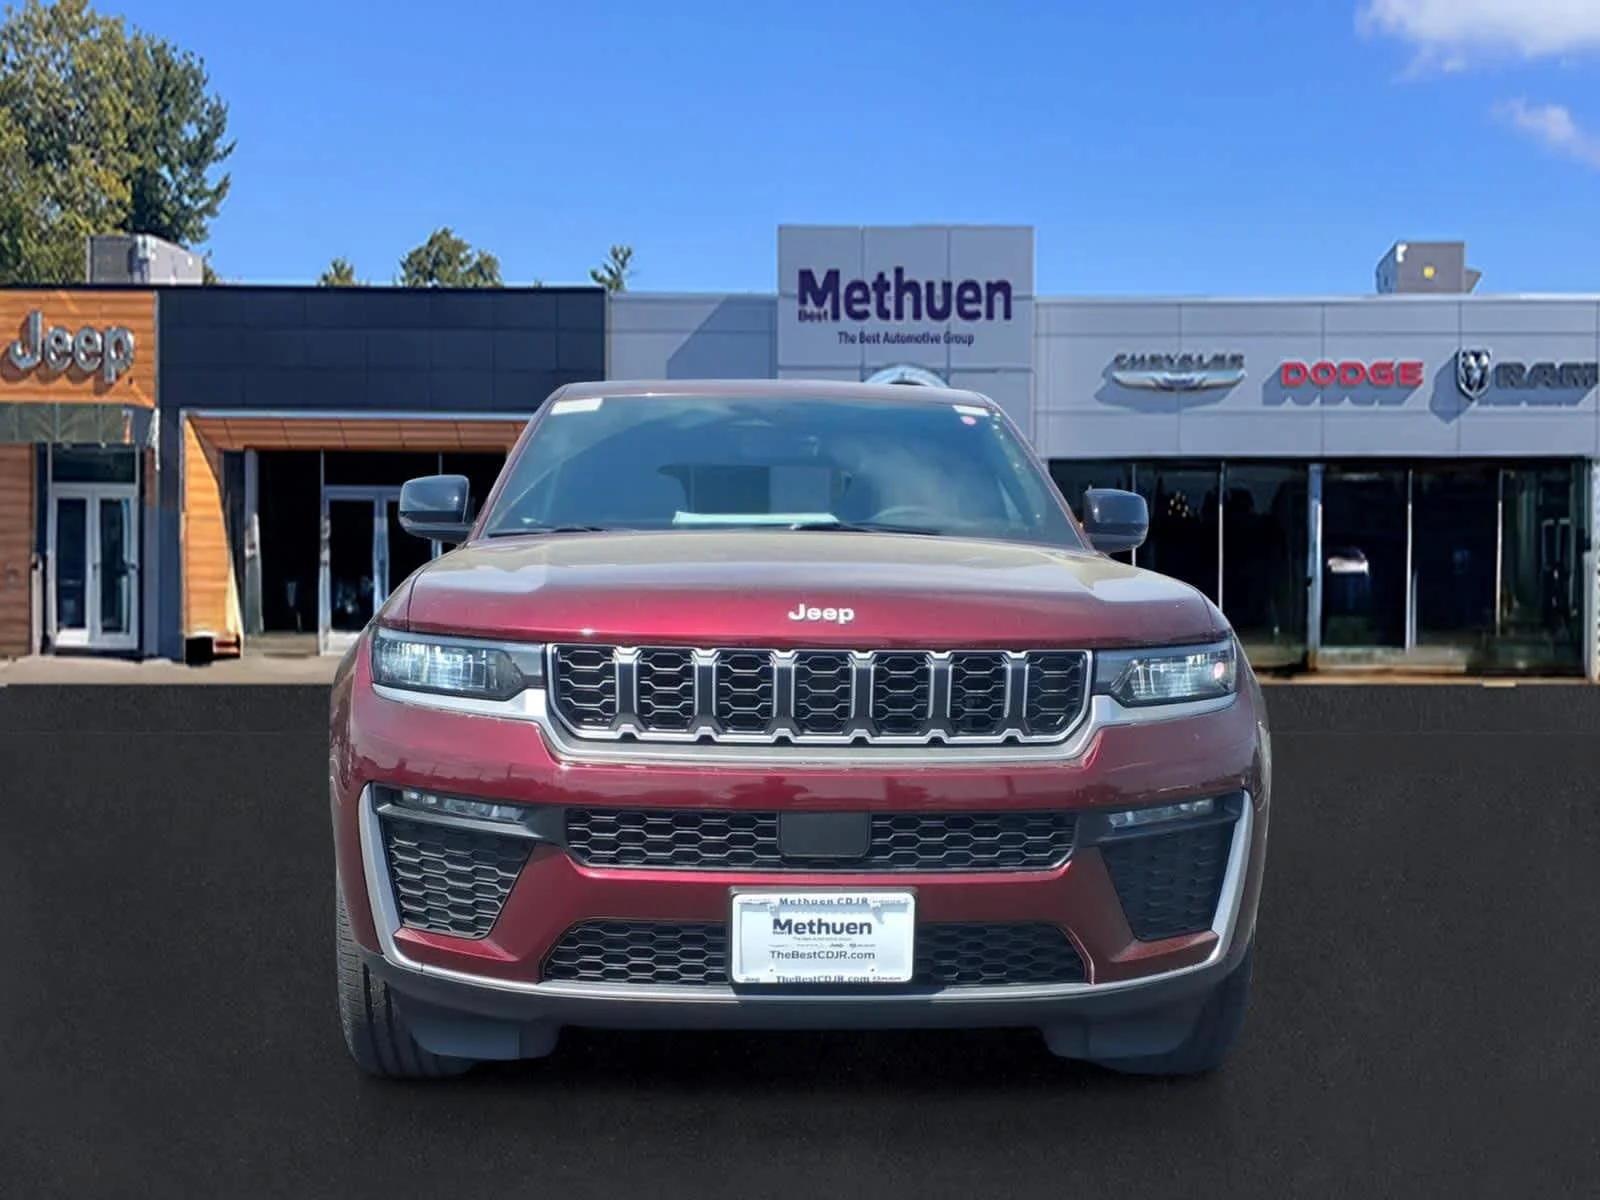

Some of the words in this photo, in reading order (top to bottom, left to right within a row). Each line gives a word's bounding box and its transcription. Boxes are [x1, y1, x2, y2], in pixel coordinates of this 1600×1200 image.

[798, 266, 1012, 321] Methuen
[9, 310, 135, 383] Jeep
[837, 331, 857, 344] The
[859, 331, 880, 344] Best
[883, 331, 941, 344] Automotive
[943, 331, 974, 347] Group
[1113, 353, 1245, 370] CHRYSLER
[1281, 361, 1424, 386] DODGE
[1495, 362, 1599, 389] RAM
[788, 603, 855, 624] Jeep
[779, 897, 833, 905] Methuen
[837, 897, 868, 905] CDJR
[772, 918, 872, 935] Methuen
[769, 950, 875, 960] TheBestCDJR.com
